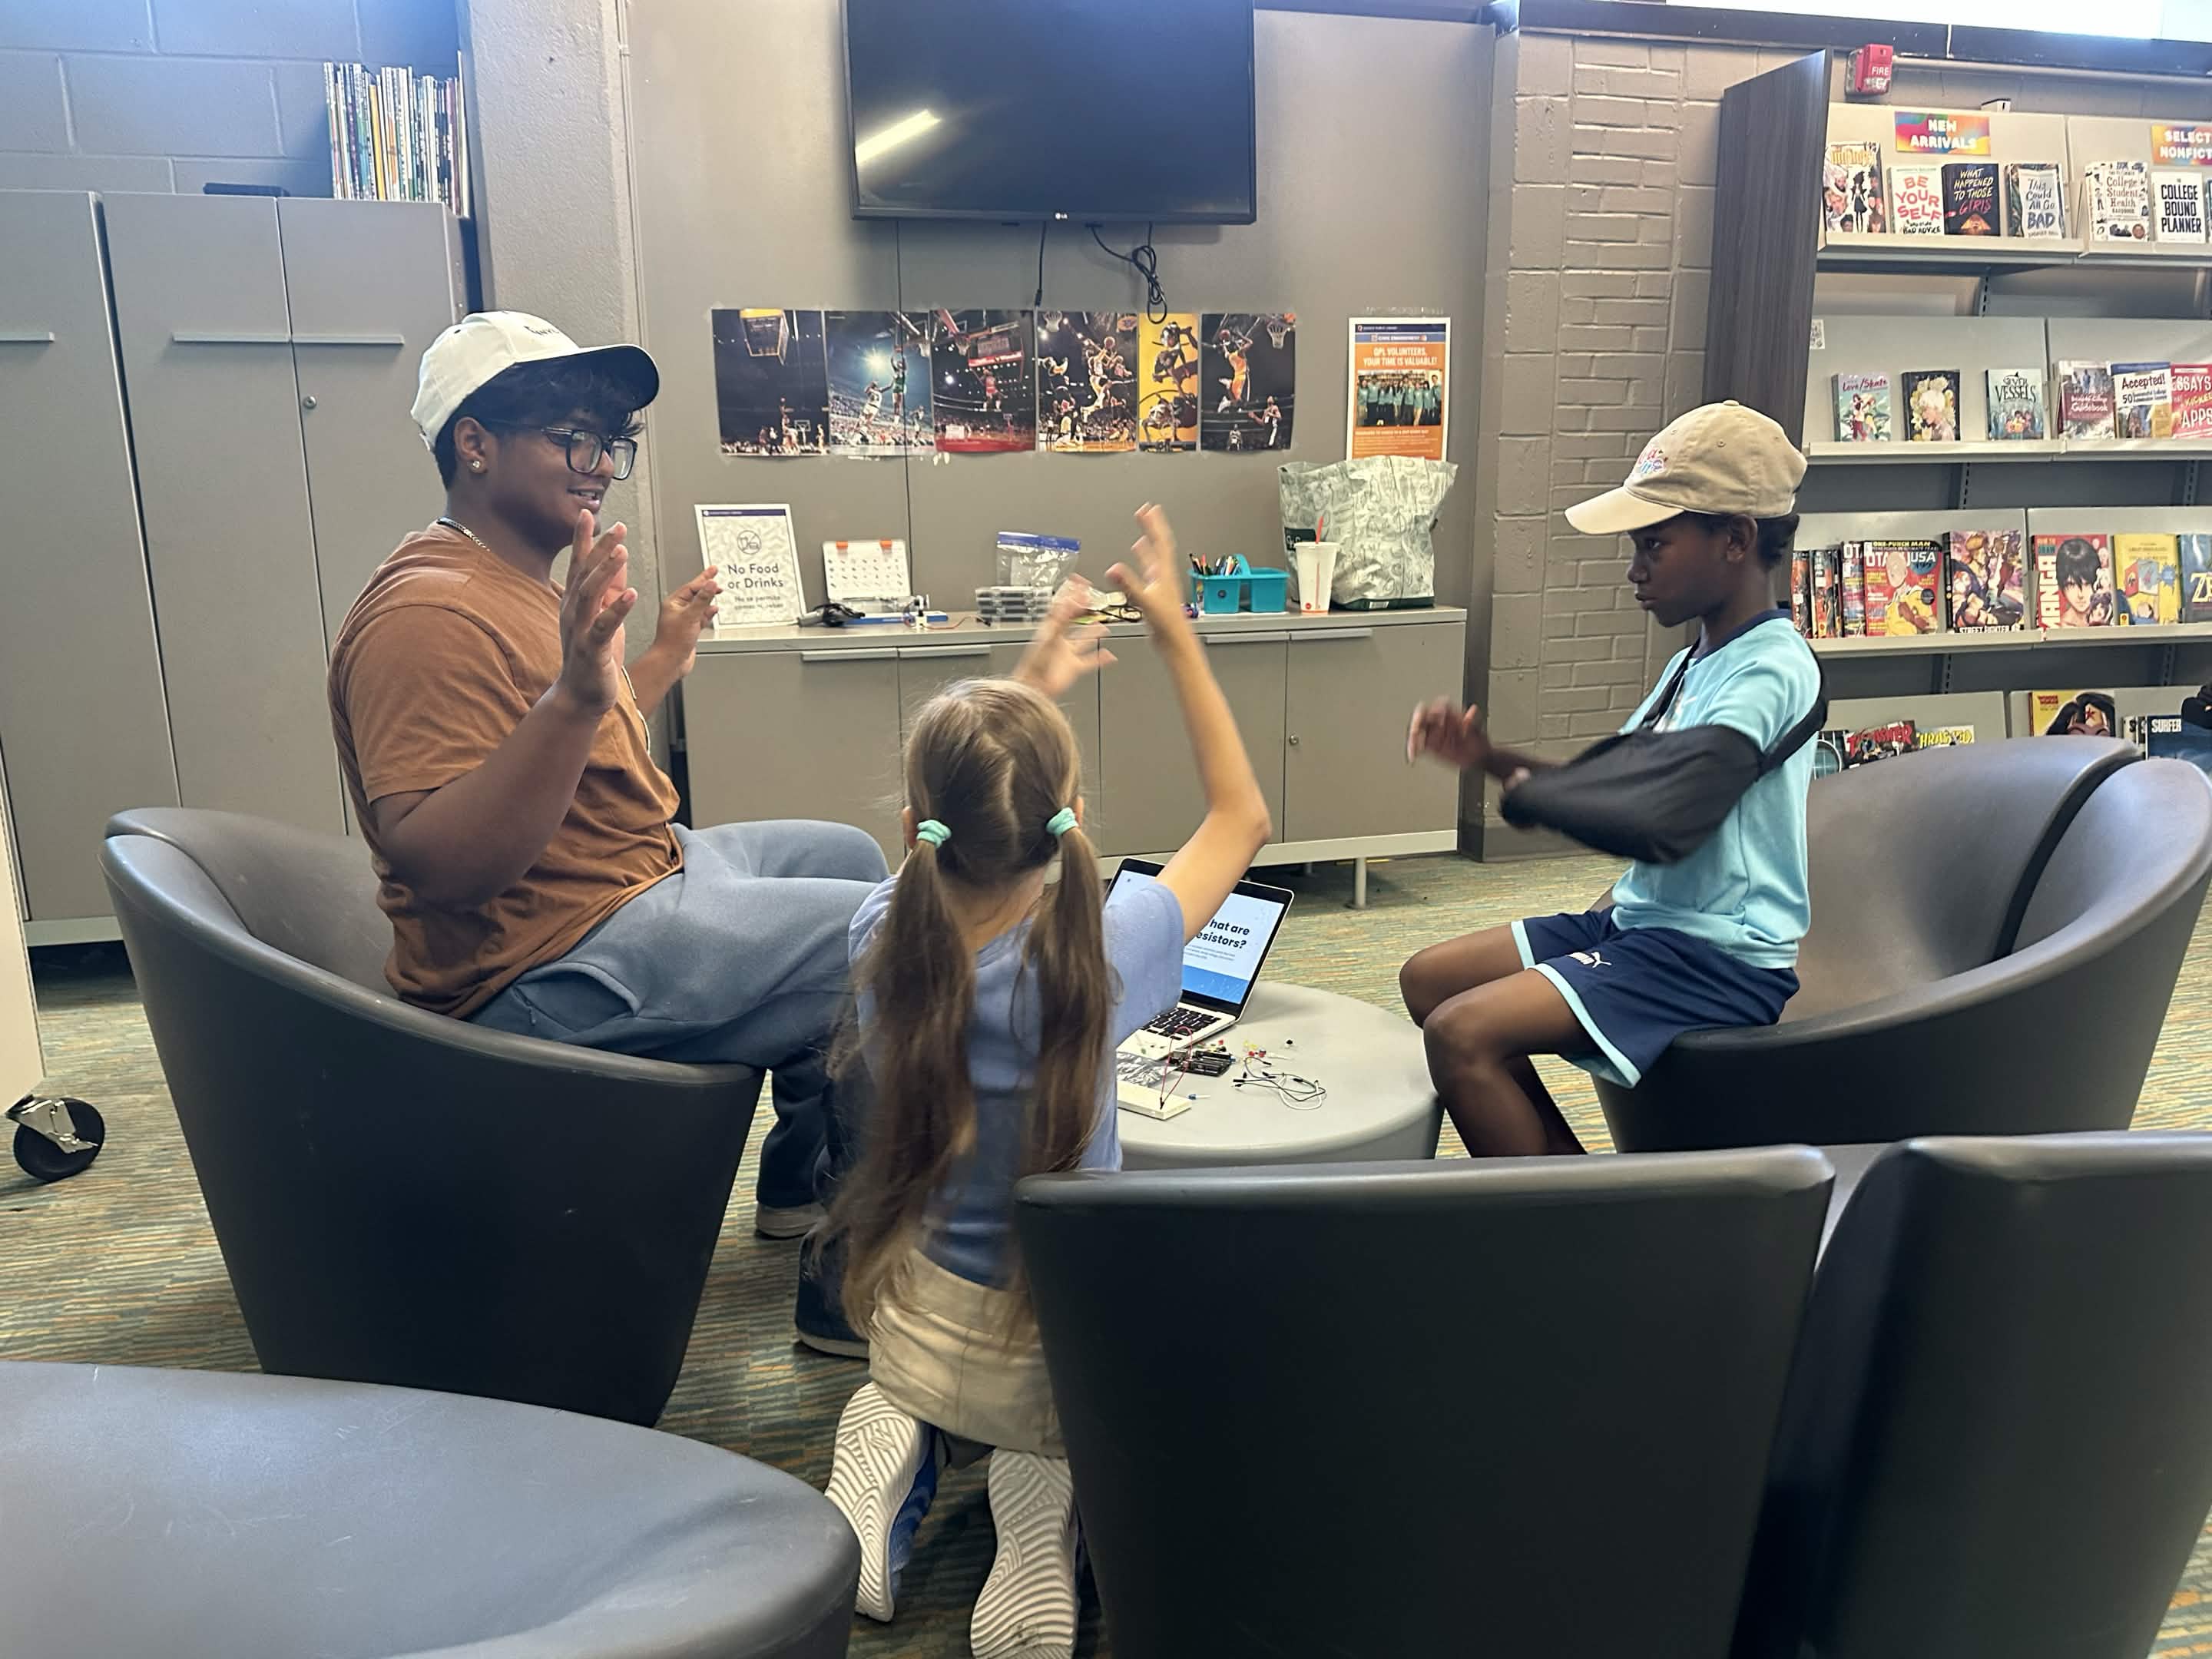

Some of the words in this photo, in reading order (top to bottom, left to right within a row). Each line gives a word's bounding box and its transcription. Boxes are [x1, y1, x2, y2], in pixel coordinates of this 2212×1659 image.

[1872, 66, 1889, 75] FIRE
[1928, 119, 1957, 132] NEW
[1910, 135, 1976, 149] ARRIVALS
[2164, 131, 2212, 144] SELECT
[1960, 168, 1984, 178] WHAT
[1904, 176, 1928, 189] BE
[1954, 177, 1994, 190] HAPPENED
[2028, 177, 2047, 190] This
[2107, 176, 2137, 189] College
[1895, 190, 1939, 207] YOUR
[1954, 190, 1965, 201] TO
[1967, 187, 1993, 198] THOSE
[2026, 189, 2052, 200] Could
[2107, 187, 2137, 197] Student
[2161, 184, 2198, 200] COLLEGE
[1959, 198, 1992, 215] GIRLS
[2029, 200, 2041, 210] All
[2043, 200, 2055, 210] Go
[2111, 197, 2136, 207] Health
[2164, 201, 2197, 216] BOUND
[1897, 204, 1942, 221] SELF
[2028, 212, 2055, 229] BAD
[2161, 217, 2201, 233] PLANNER
[1363, 356, 1380, 366] YOUR
[1382, 356, 1396, 366] TIME
[1396, 356, 1403, 366] IS
[2121, 373, 2166, 389] Accepted!
[2171, 376, 2211, 392] ESSAYS
[1995, 385, 2036, 402] VESSELS
[2122, 393, 2133, 404] 50
[2181, 408, 2212, 429] APPS
[1910, 551, 1936, 562] USA
[727, 563, 745, 575] No
[750, 562, 779, 574] Food
[744, 578, 783, 588] Drinks
[2151, 718, 2181, 733] SURFER
[1210, 919, 1230, 931] hat
[1230, 926, 1250, 935] are
[1196, 930, 1247, 949] esistors?
